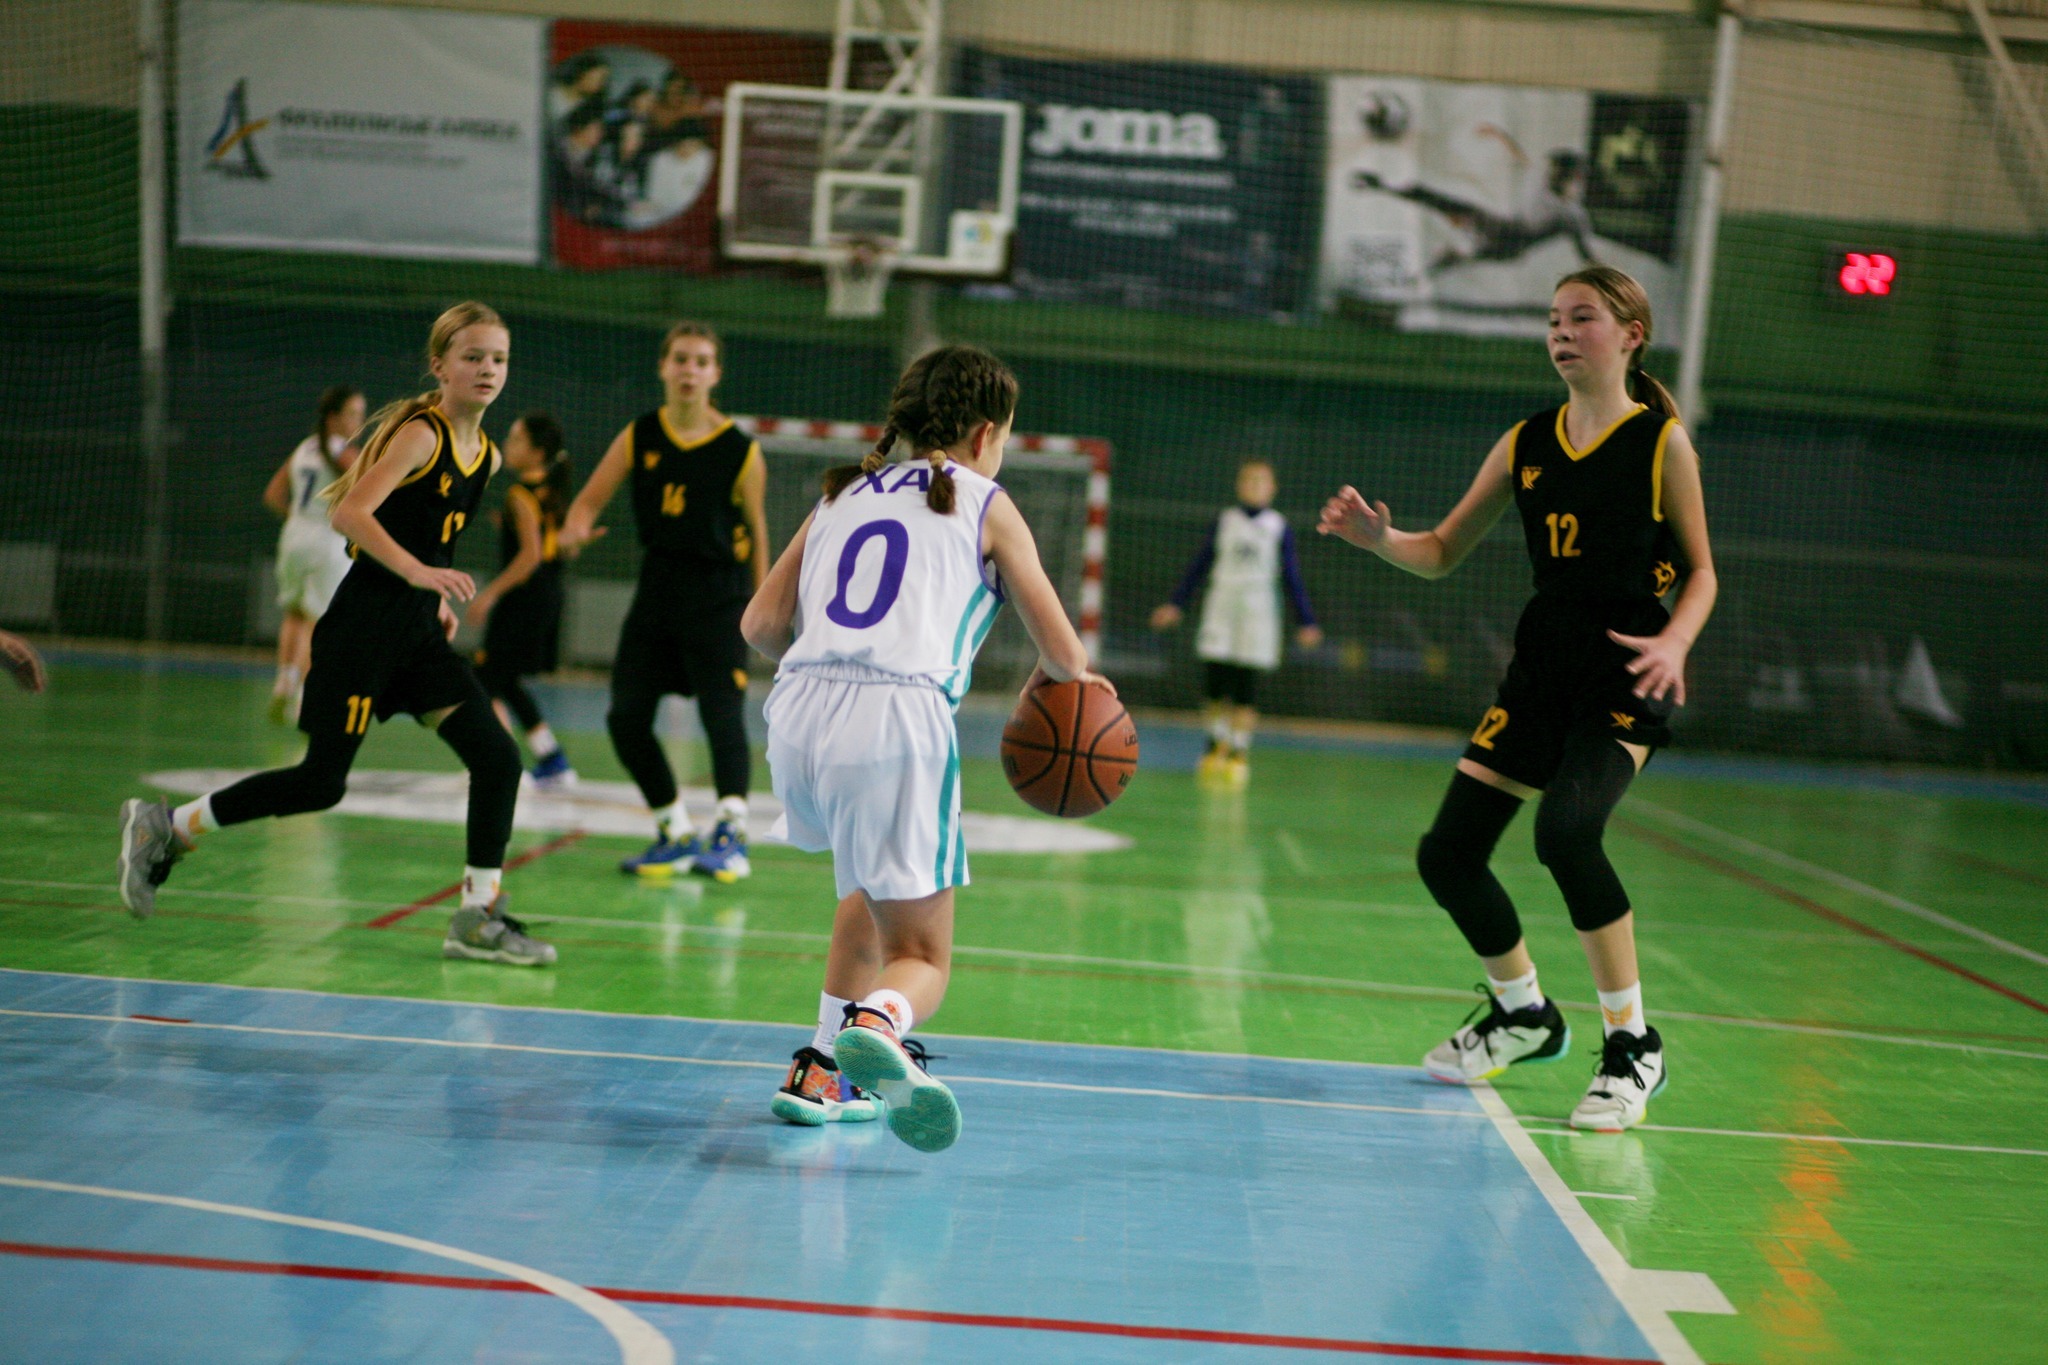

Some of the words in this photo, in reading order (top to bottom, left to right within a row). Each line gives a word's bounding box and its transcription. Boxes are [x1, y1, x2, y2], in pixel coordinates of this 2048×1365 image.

[301, 467, 317, 508] 7
[661, 482, 686, 516] 16
[1545, 512, 1582, 558] 12
[826, 519, 909, 629] 0
[345, 694, 372, 734] 11
